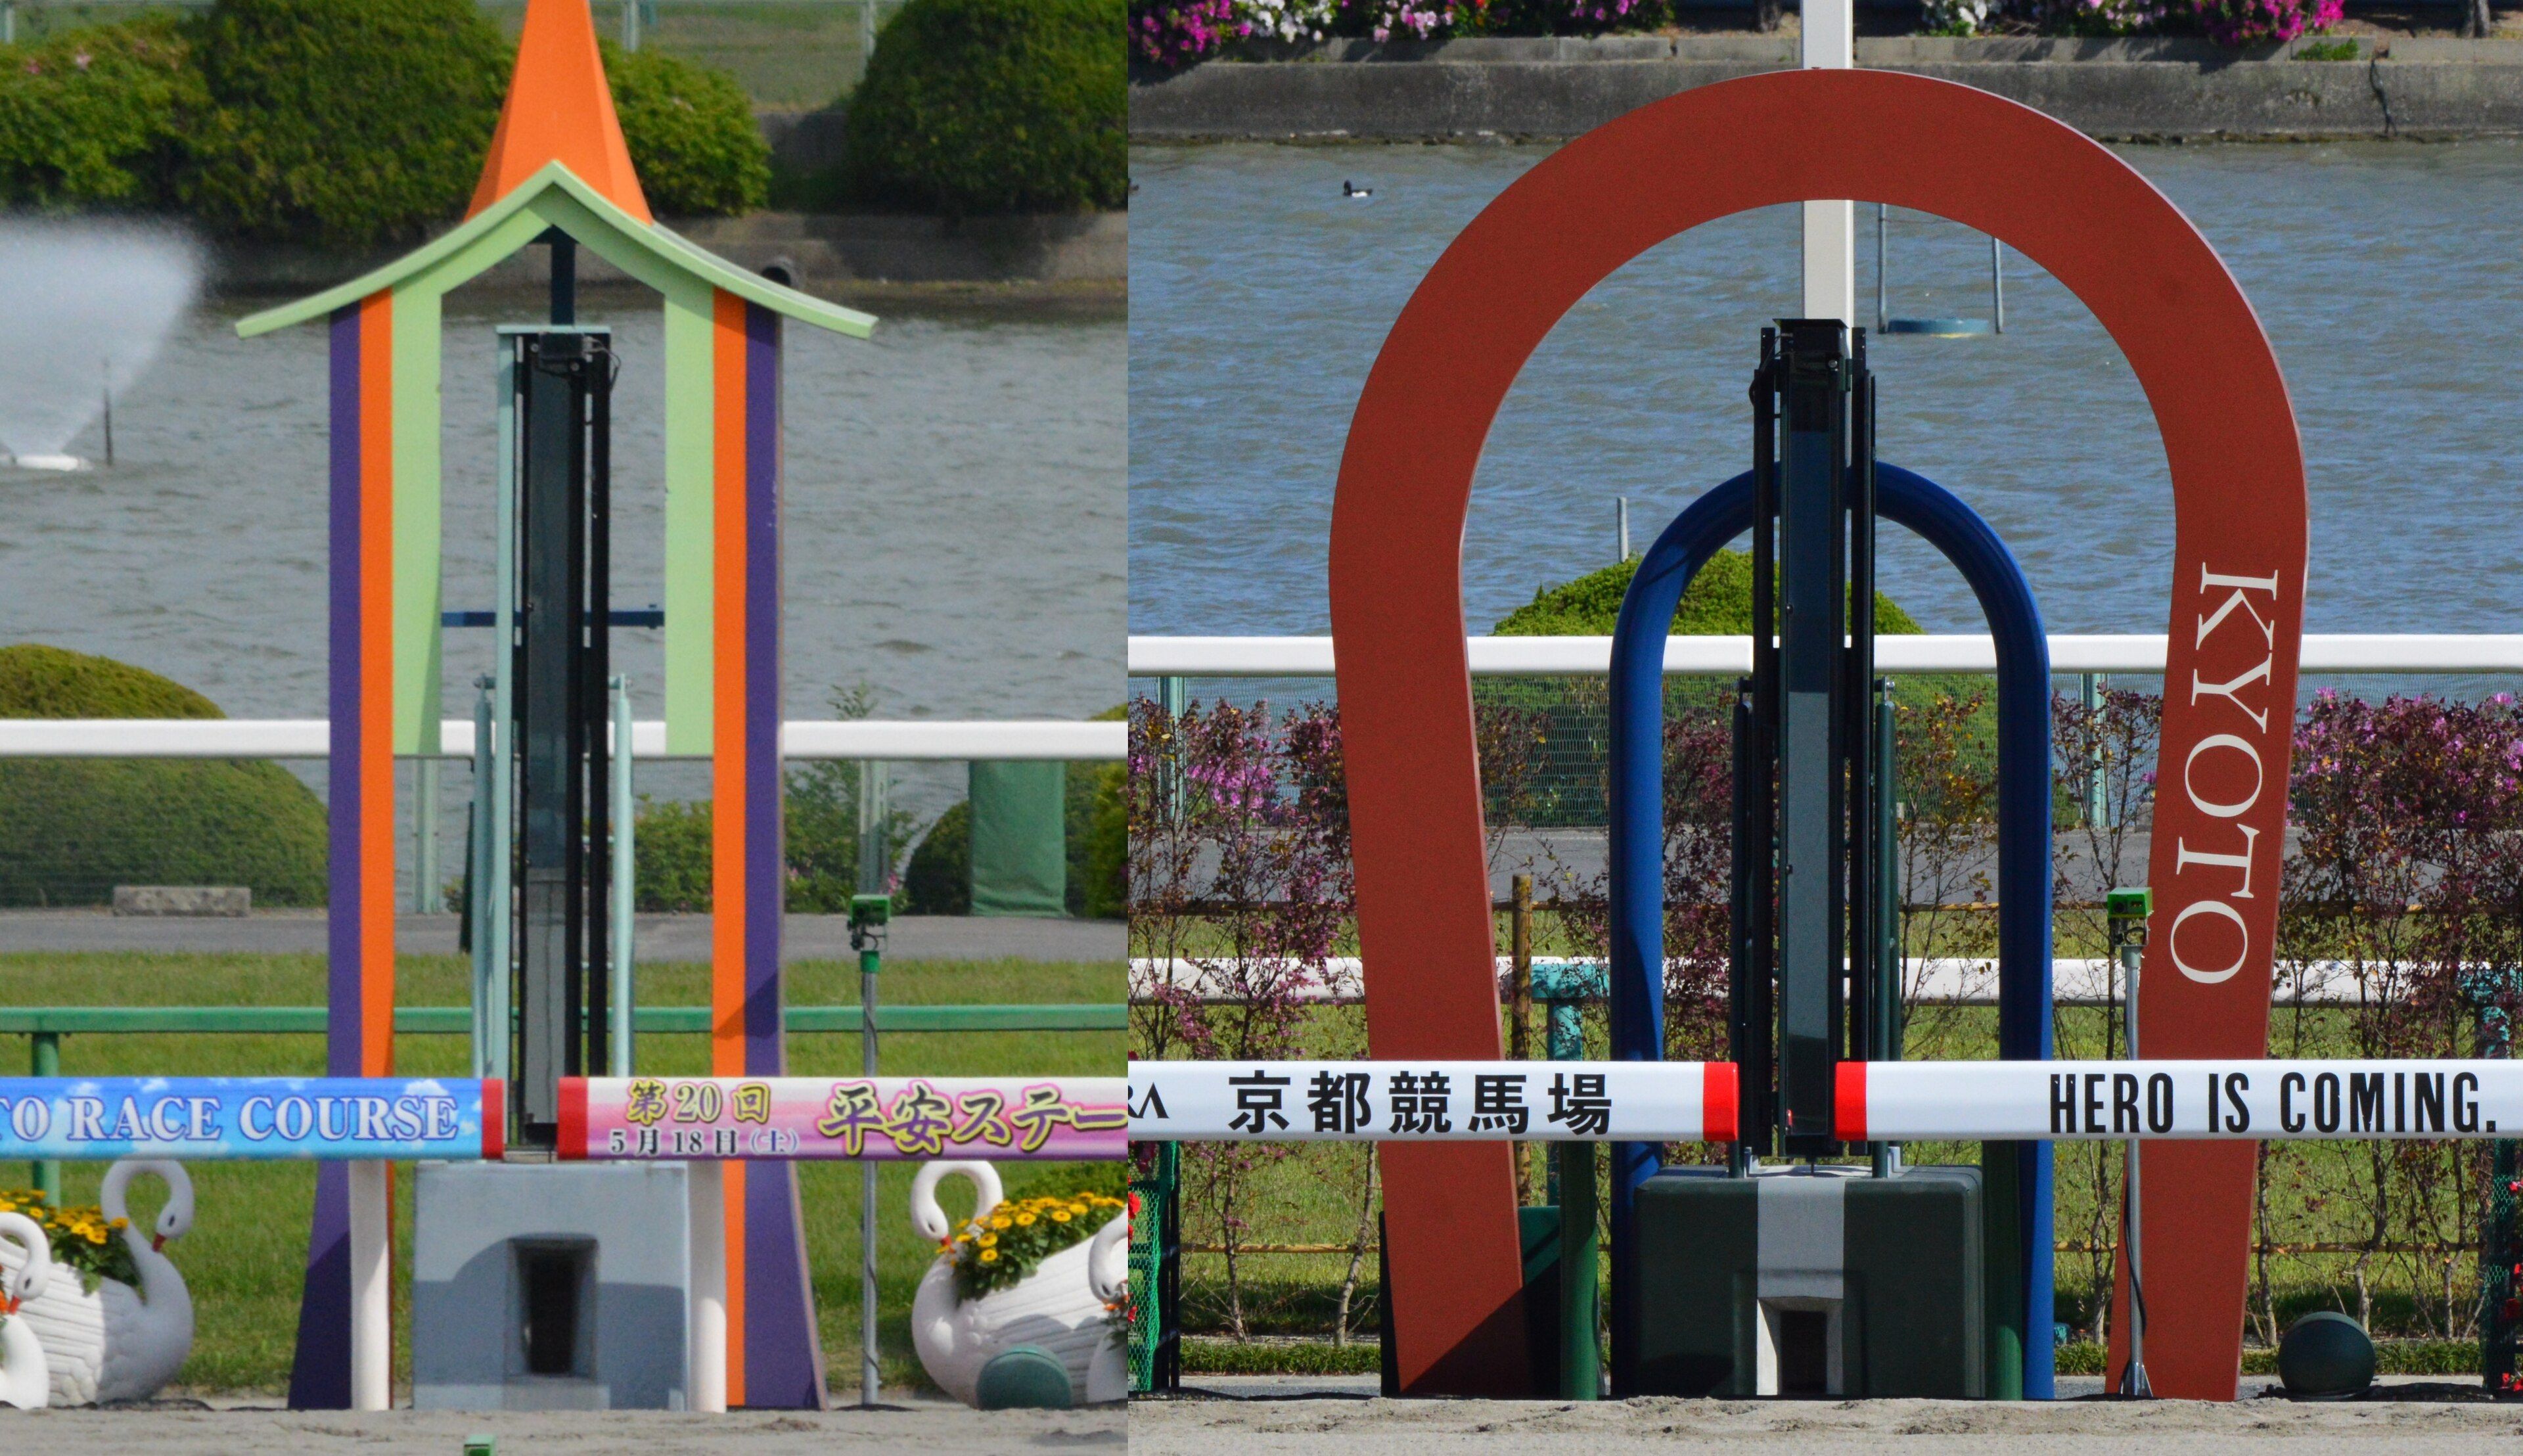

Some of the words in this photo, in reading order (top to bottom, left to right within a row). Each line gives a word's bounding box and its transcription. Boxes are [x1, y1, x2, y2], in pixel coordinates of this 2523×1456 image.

[2170, 562, 2279, 984] KYOTO
[67, 1095, 222, 1141] RACE
[239, 1095, 459, 1141] COURSE
[626, 1080, 771, 1126] 第20回
[819, 1081, 1127, 1156] 平安ステー
[1228, 1070, 1612, 1135] 京都競馬場
[2050, 1072, 2174, 1134] HERO
[2208, 1072, 2250, 1134] IS
[2280, 1072, 2497, 1134] COMING.
